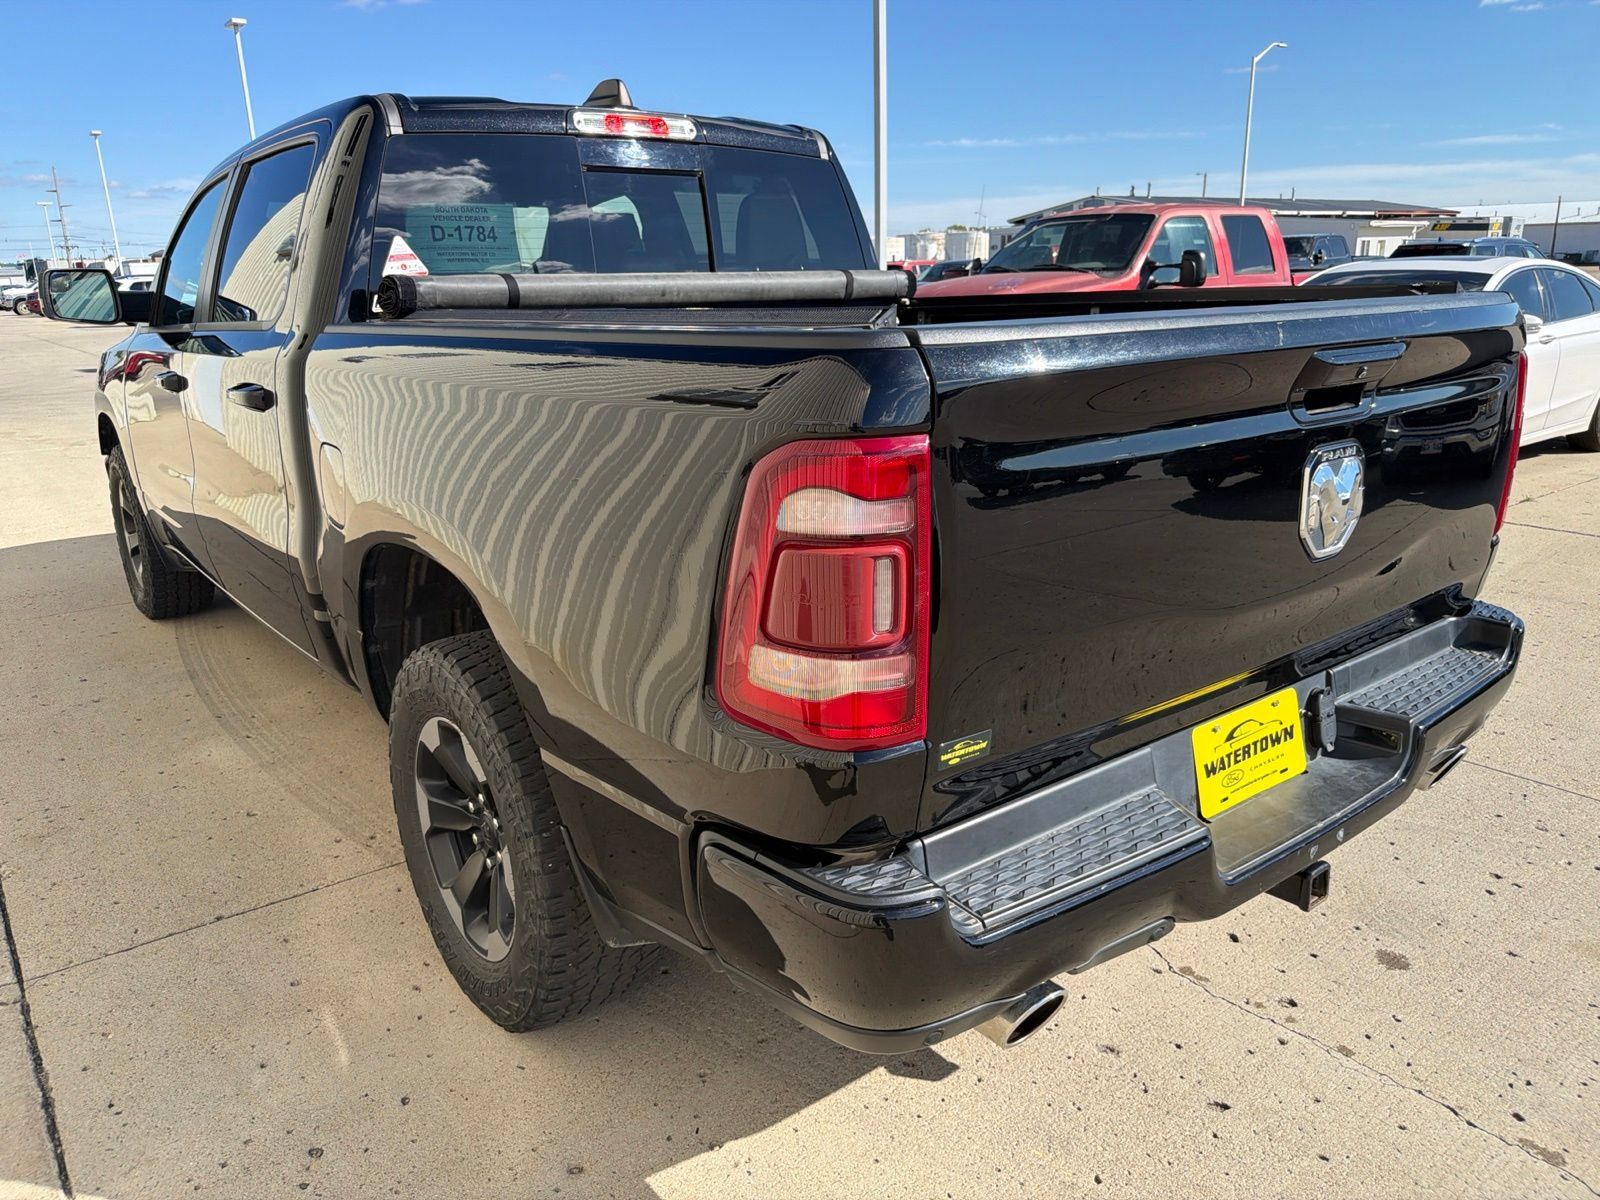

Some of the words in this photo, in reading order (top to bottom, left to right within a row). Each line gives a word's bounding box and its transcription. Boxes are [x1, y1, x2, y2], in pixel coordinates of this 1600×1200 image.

[430, 225, 498, 243] D-1784
[1321, 445, 1357, 462] RAM
[1203, 724, 1295, 779] WATERTOWN
